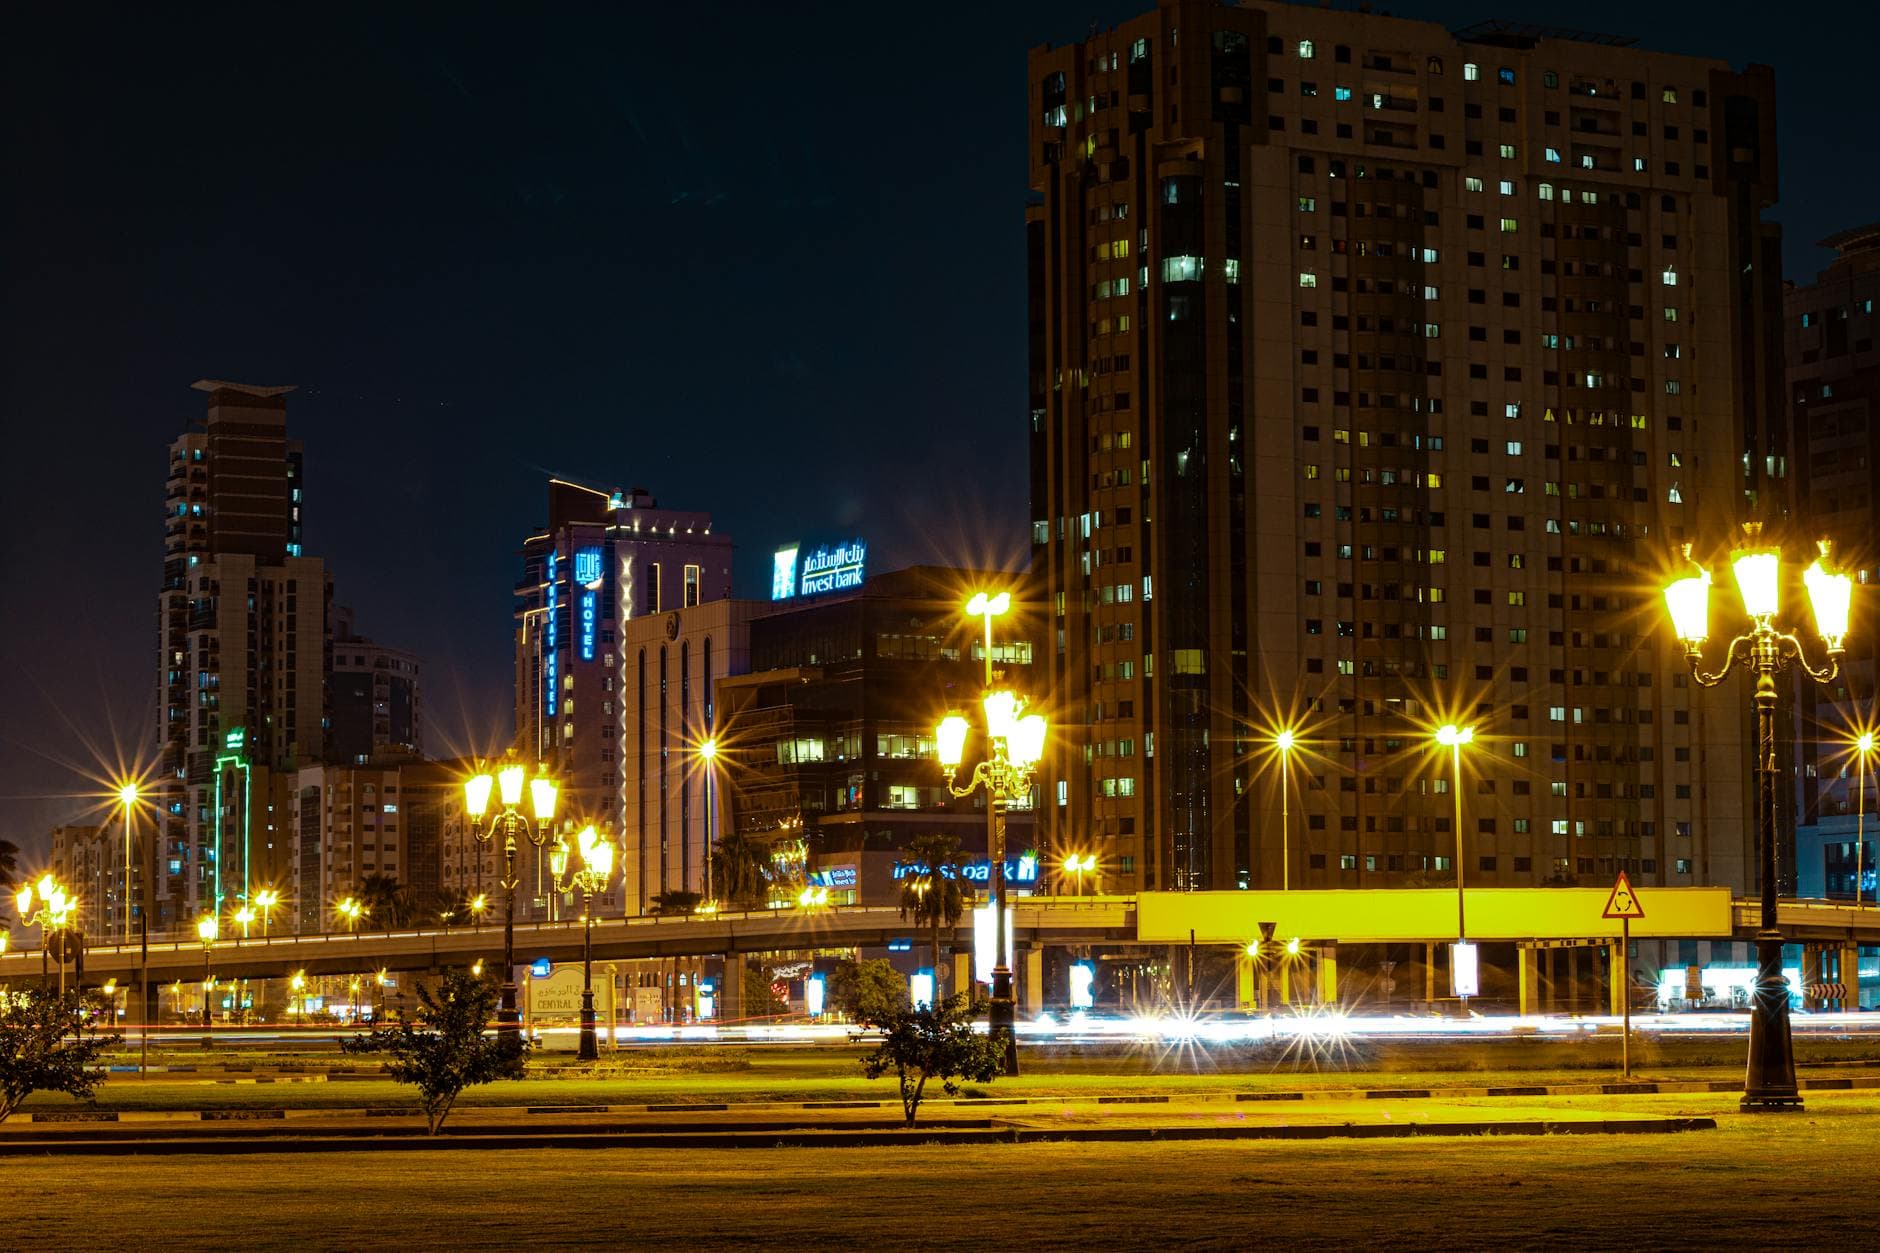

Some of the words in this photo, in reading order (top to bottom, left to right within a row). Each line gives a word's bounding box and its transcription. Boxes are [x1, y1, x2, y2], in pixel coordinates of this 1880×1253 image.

[835, 567, 863, 588] bank
[583, 597, 593, 658] HOTEL
[537, 999, 573, 1009] CENTRAL
[577, 999, 600, 1010] SQ
